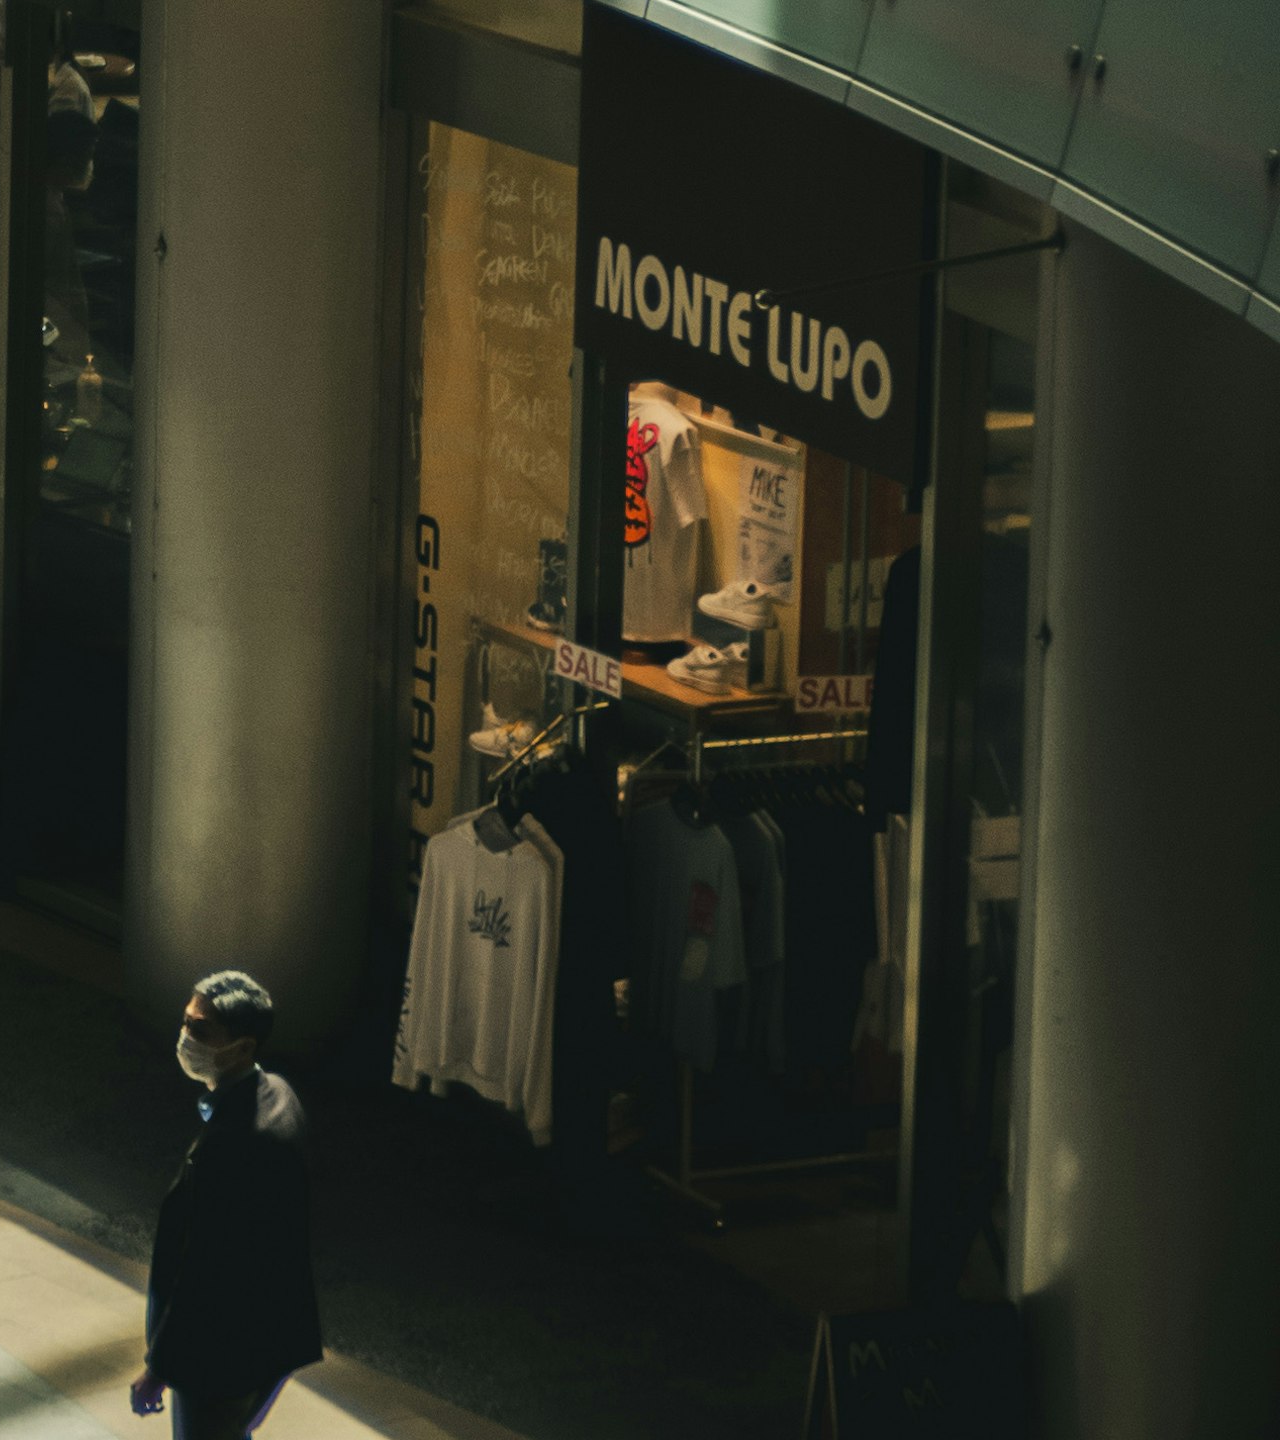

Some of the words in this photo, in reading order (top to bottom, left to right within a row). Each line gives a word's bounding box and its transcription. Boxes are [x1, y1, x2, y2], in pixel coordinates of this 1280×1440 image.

[593, 235, 753, 366] MONTE
[765, 315, 894, 420] LUPO
[408, 513, 441, 810] G-STAR
[557, 642, 620, 693] SALE
